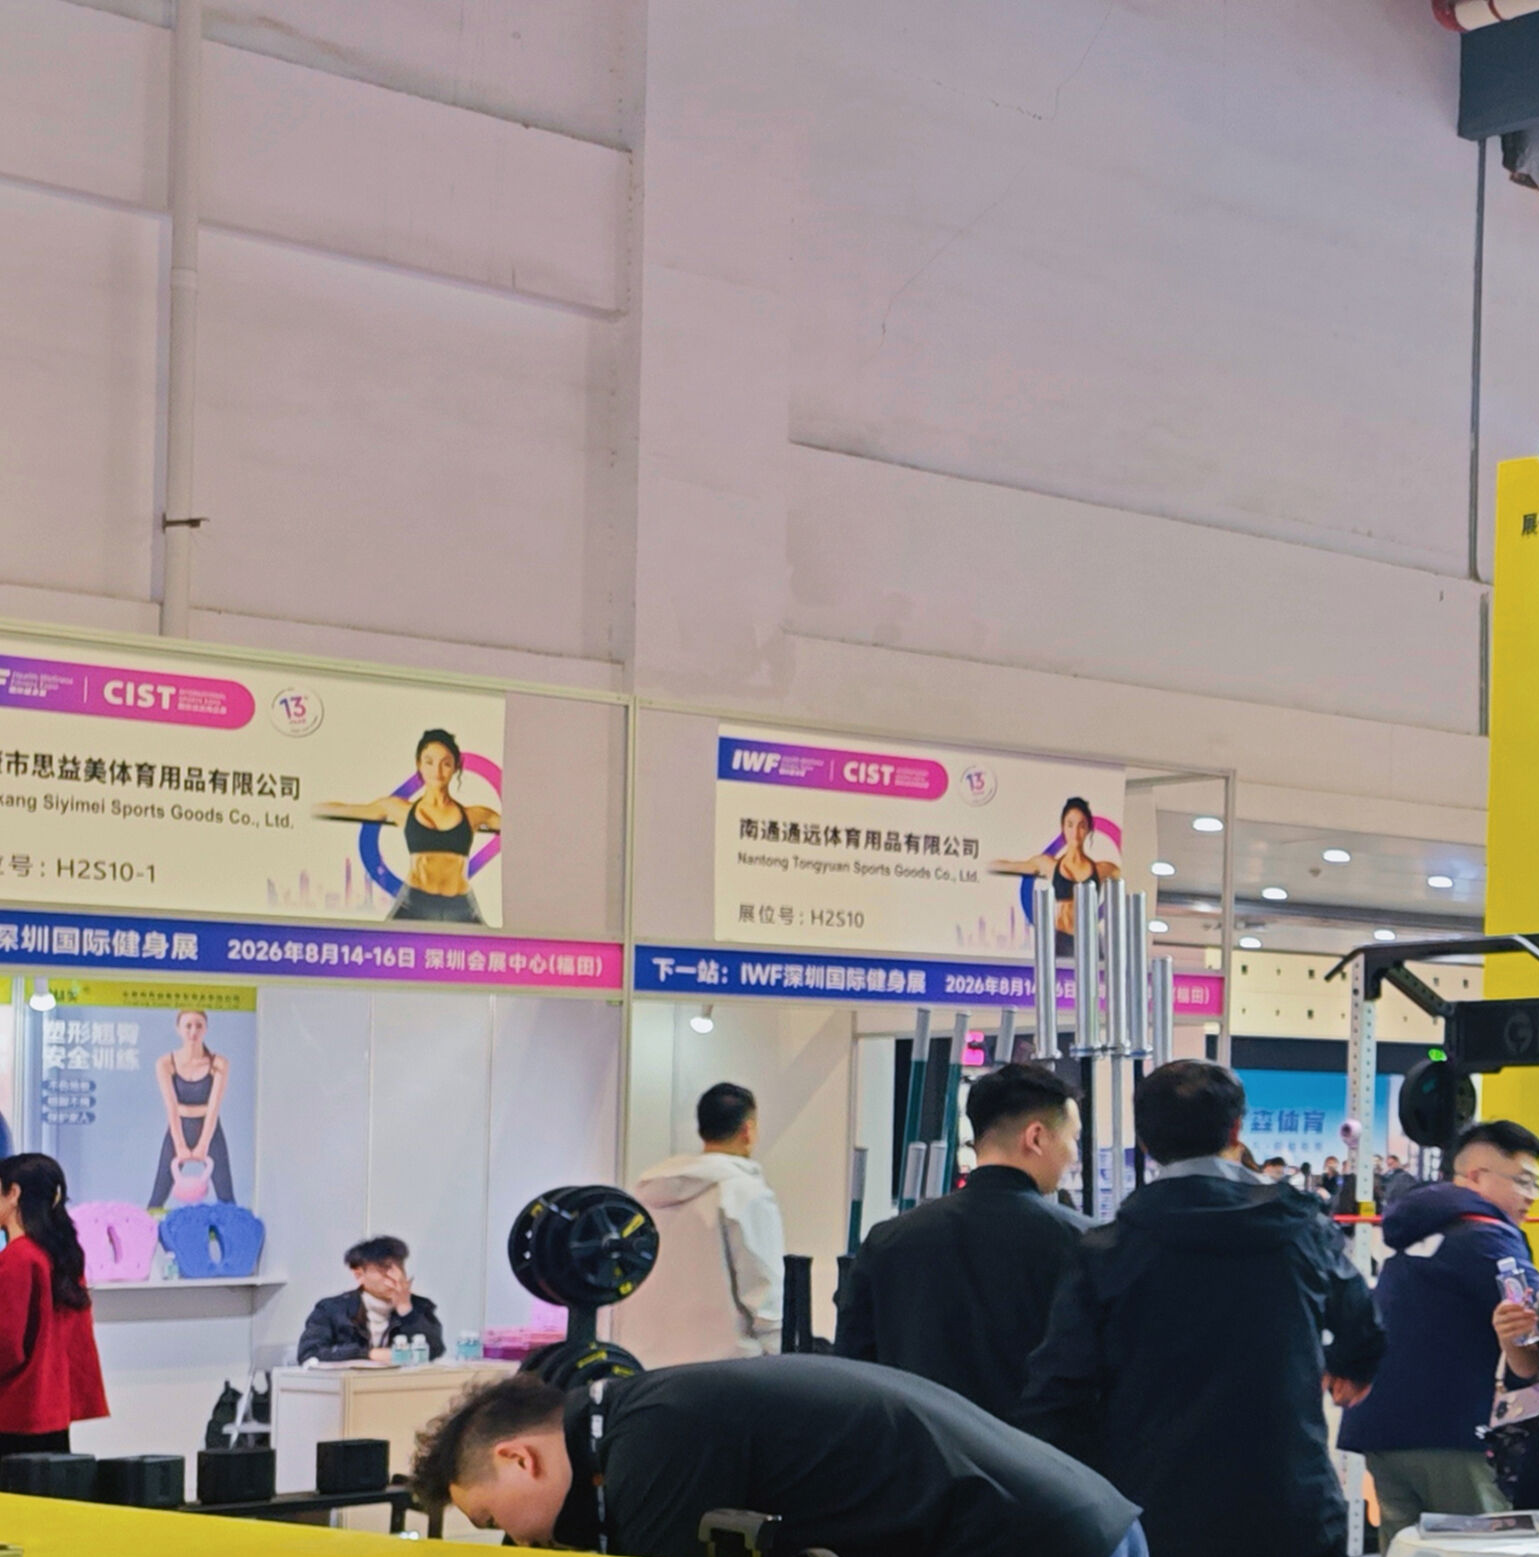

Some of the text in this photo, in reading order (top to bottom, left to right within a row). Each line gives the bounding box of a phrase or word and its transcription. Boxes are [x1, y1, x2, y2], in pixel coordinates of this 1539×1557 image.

[103, 680, 177, 710] CIST
[0, 749, 301, 801] 市思益美体育用品有限公司
[731, 748, 781, 774] IWF
[843, 761, 895, 787] CIST
[43, 793, 106, 817] Siyimei
[111, 799, 165, 822] Sports
[171, 801, 224, 825] Goods
[229, 809, 260, 829] Co.,
[264, 811, 295, 830] Ltd.
[739, 817, 981, 860] 南通通远体育用品有限公司
[0, 853, 156, 884] 号：H2S10-1
[737, 851, 789, 871] Nantong
[793, 854, 851, 876] Tongyuan
[853, 860, 891, 878] Sports
[894, 863, 932, 880] Goods
[227, 938, 416, 969] 2026年8月14-16日
